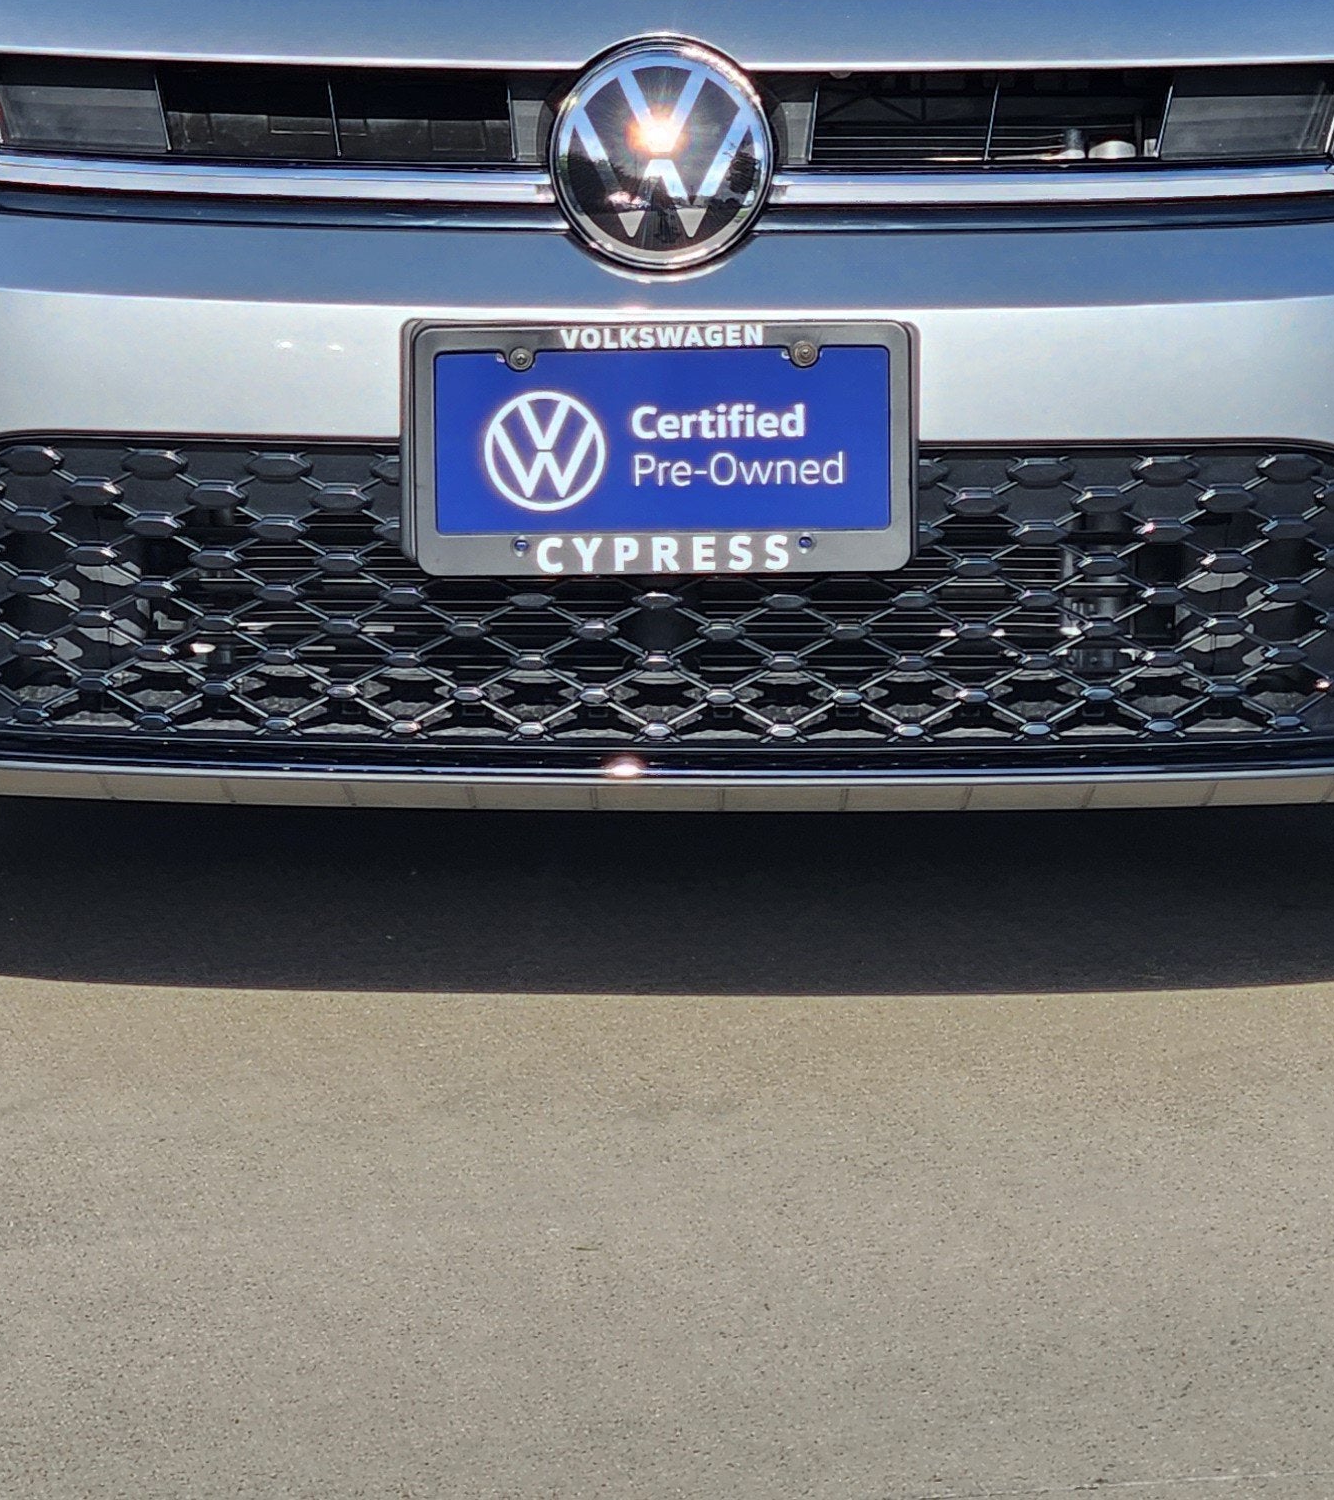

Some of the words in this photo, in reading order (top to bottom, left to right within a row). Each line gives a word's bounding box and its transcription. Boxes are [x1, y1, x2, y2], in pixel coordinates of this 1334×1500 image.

[560, 324, 765, 350] VOLKSWAGEN
[630, 403, 806, 440] Certified
[633, 450, 845, 487] Pre-Owned
[535, 534, 790, 573] CYPRESS
